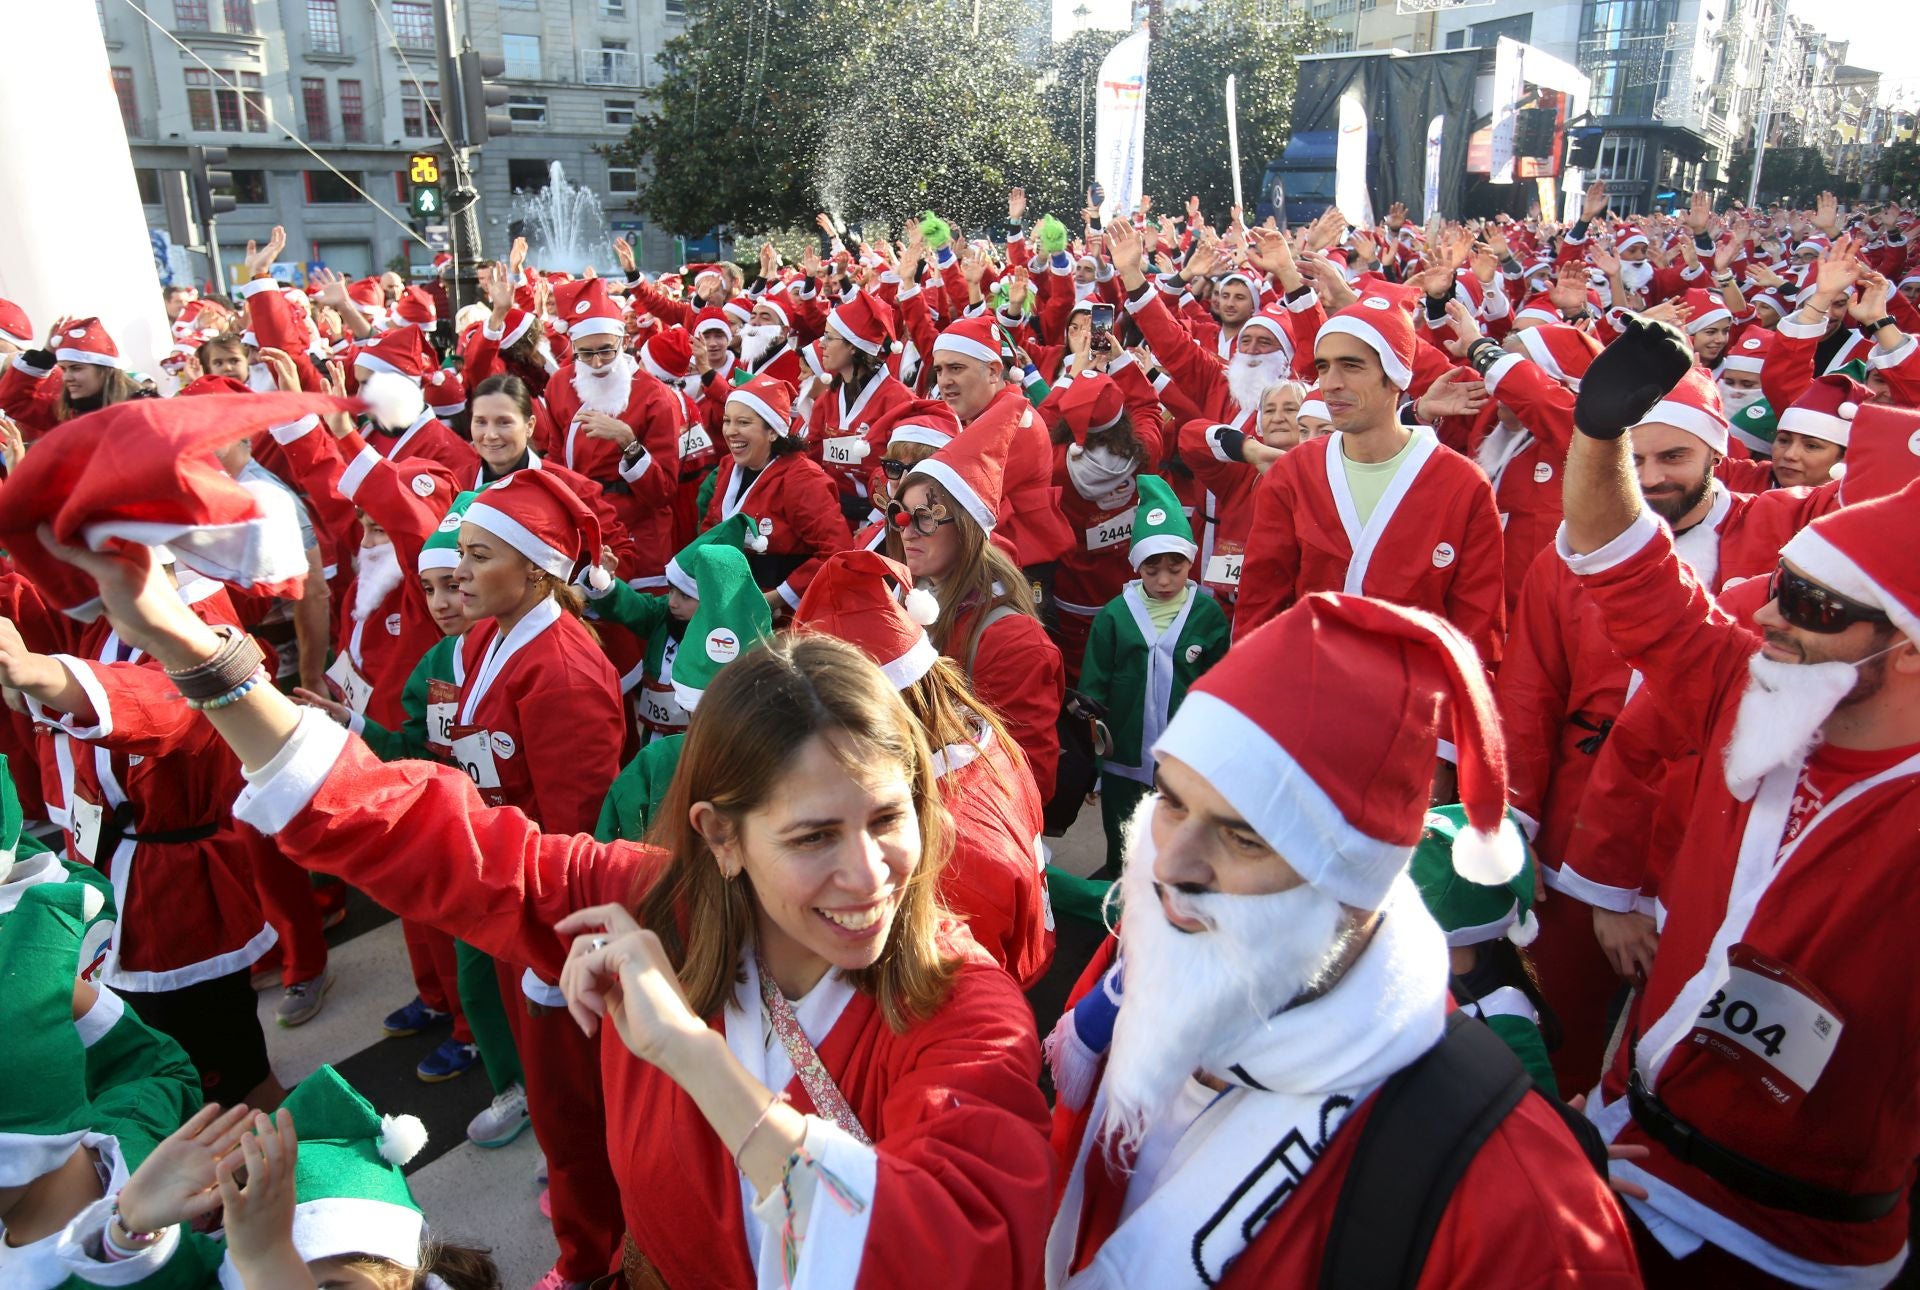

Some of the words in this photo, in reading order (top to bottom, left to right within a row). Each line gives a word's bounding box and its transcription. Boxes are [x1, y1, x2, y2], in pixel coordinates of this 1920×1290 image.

[411, 156, 438, 182] 26
[830, 446, 849, 461] 2161
[1100, 524, 1132, 542] 2444
[1225, 563, 1241, 580] 14
[647, 700, 670, 722] 783
[1699, 989, 1786, 1057] 304
